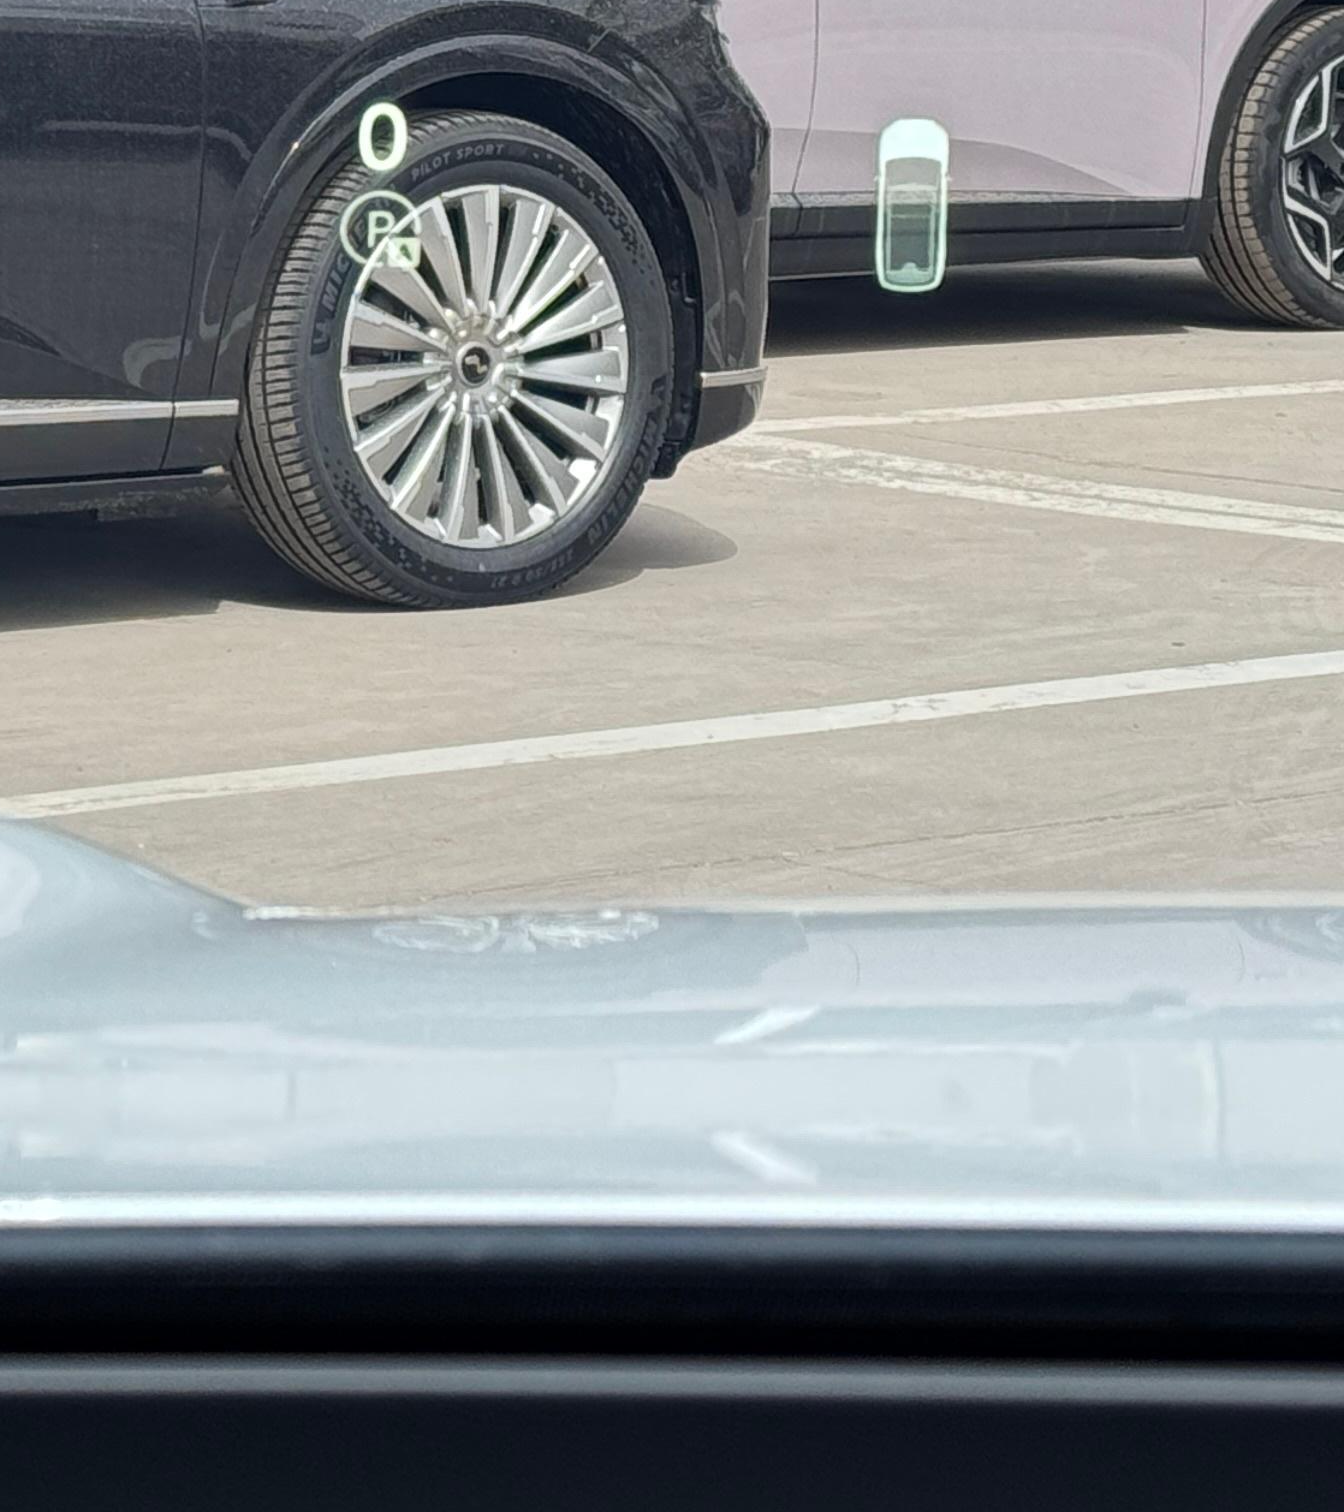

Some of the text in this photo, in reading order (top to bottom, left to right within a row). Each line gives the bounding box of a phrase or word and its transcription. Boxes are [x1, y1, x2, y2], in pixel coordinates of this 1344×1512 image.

[359, 102, 408, 172] 0
[411, 151, 451, 182] PILOT
[455, 143, 504, 161] SPORT
[367, 210, 396, 248] P
